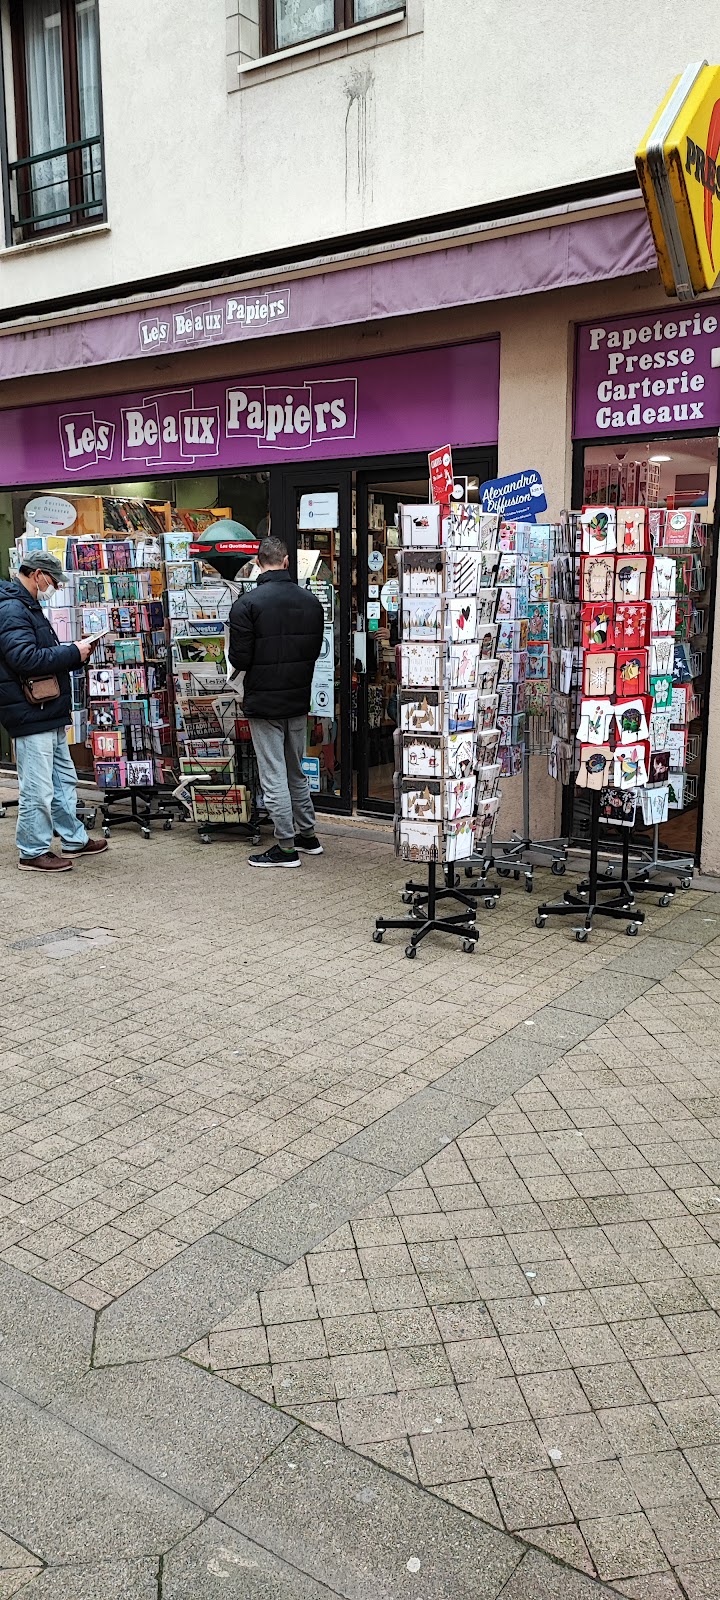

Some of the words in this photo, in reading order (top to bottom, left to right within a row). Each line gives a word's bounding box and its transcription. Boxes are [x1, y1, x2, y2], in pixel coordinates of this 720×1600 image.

[141, 323, 167, 344] Les
[175, 314, 221, 336] Beaux
[227, 299, 285, 324] Papiers
[589, 313, 718, 351] Papeterie
[608, 348, 695, 375] Presse
[597, 371, 704, 402] Carterie
[64, 422, 109, 457] Les
[126, 411, 215, 447] Beaux
[228, 391, 347, 441] Papiers
[595, 402, 704, 429] Cadeaux
[482, 473, 538, 503] Alexandra
[487, 492, 532, 514] Diffusion
